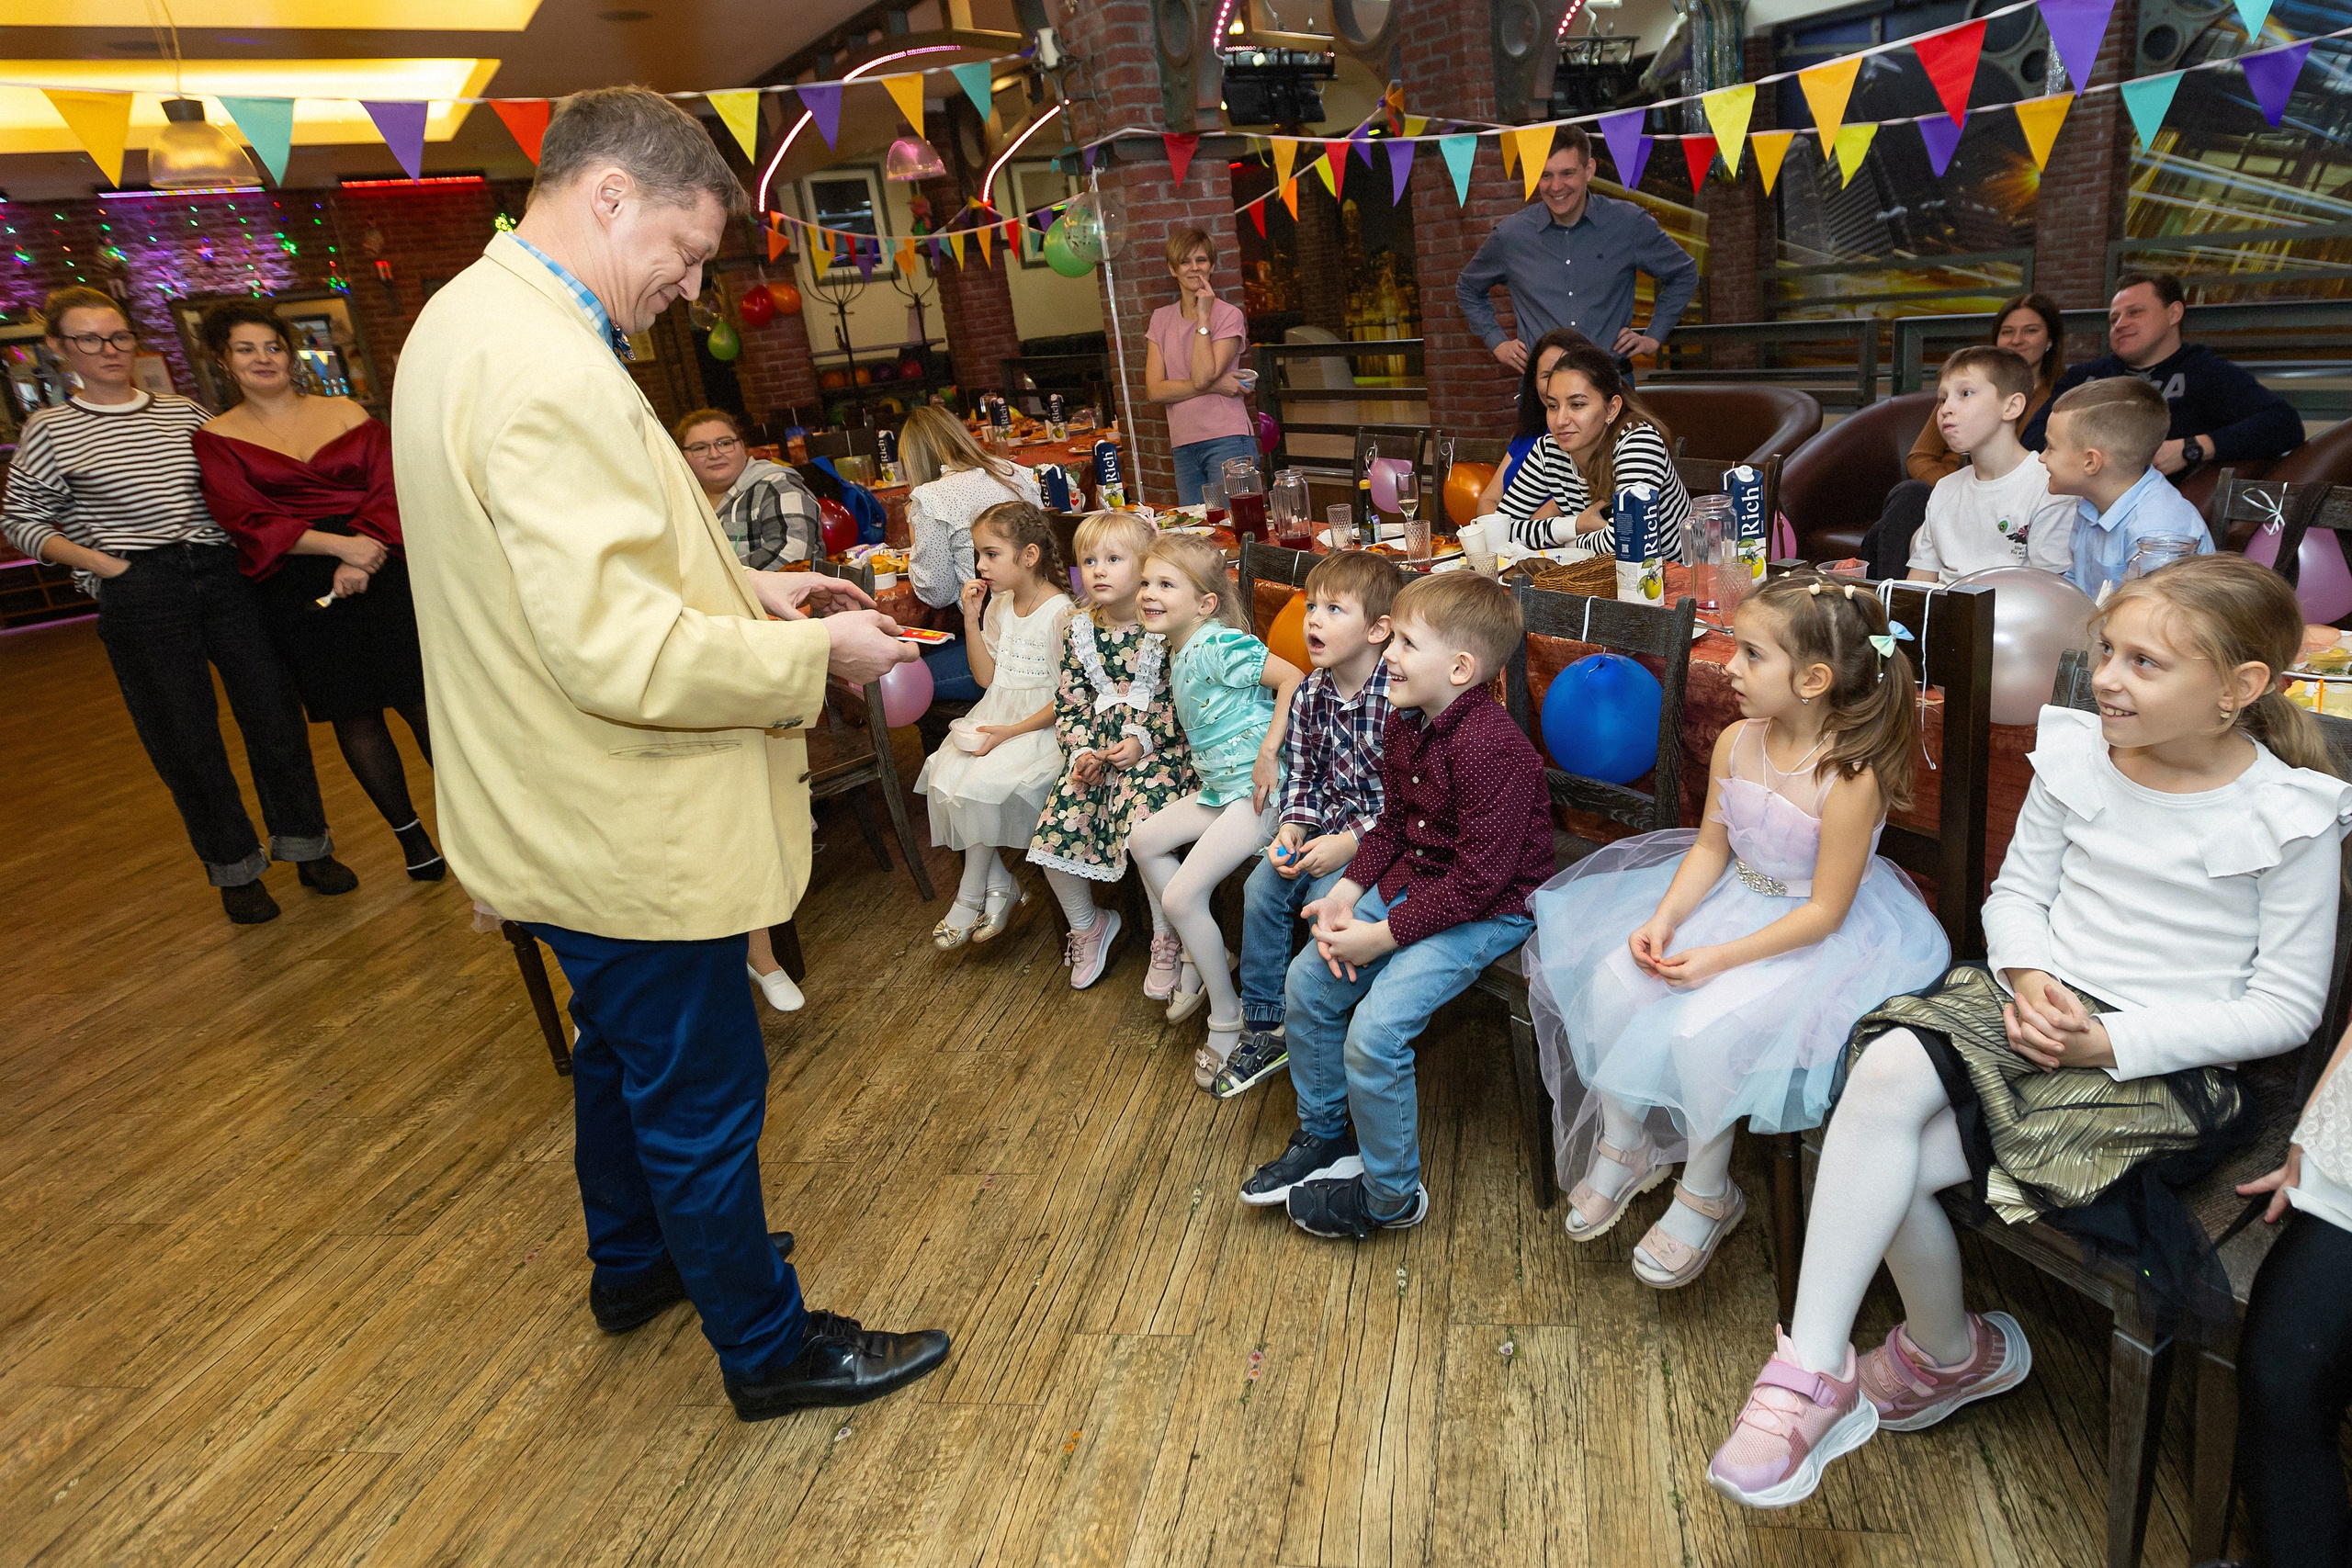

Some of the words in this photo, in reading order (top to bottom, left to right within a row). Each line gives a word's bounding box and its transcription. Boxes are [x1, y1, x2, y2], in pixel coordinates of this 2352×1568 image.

[999, 404, 1009, 424] Rich
[1051, 401, 1060, 423] Rich
[877, 439, 888, 462] Rich
[1102, 451, 1118, 482] Rich
[1740, 486, 1759, 537] Rich
[1643, 504, 1658, 557] Rich
